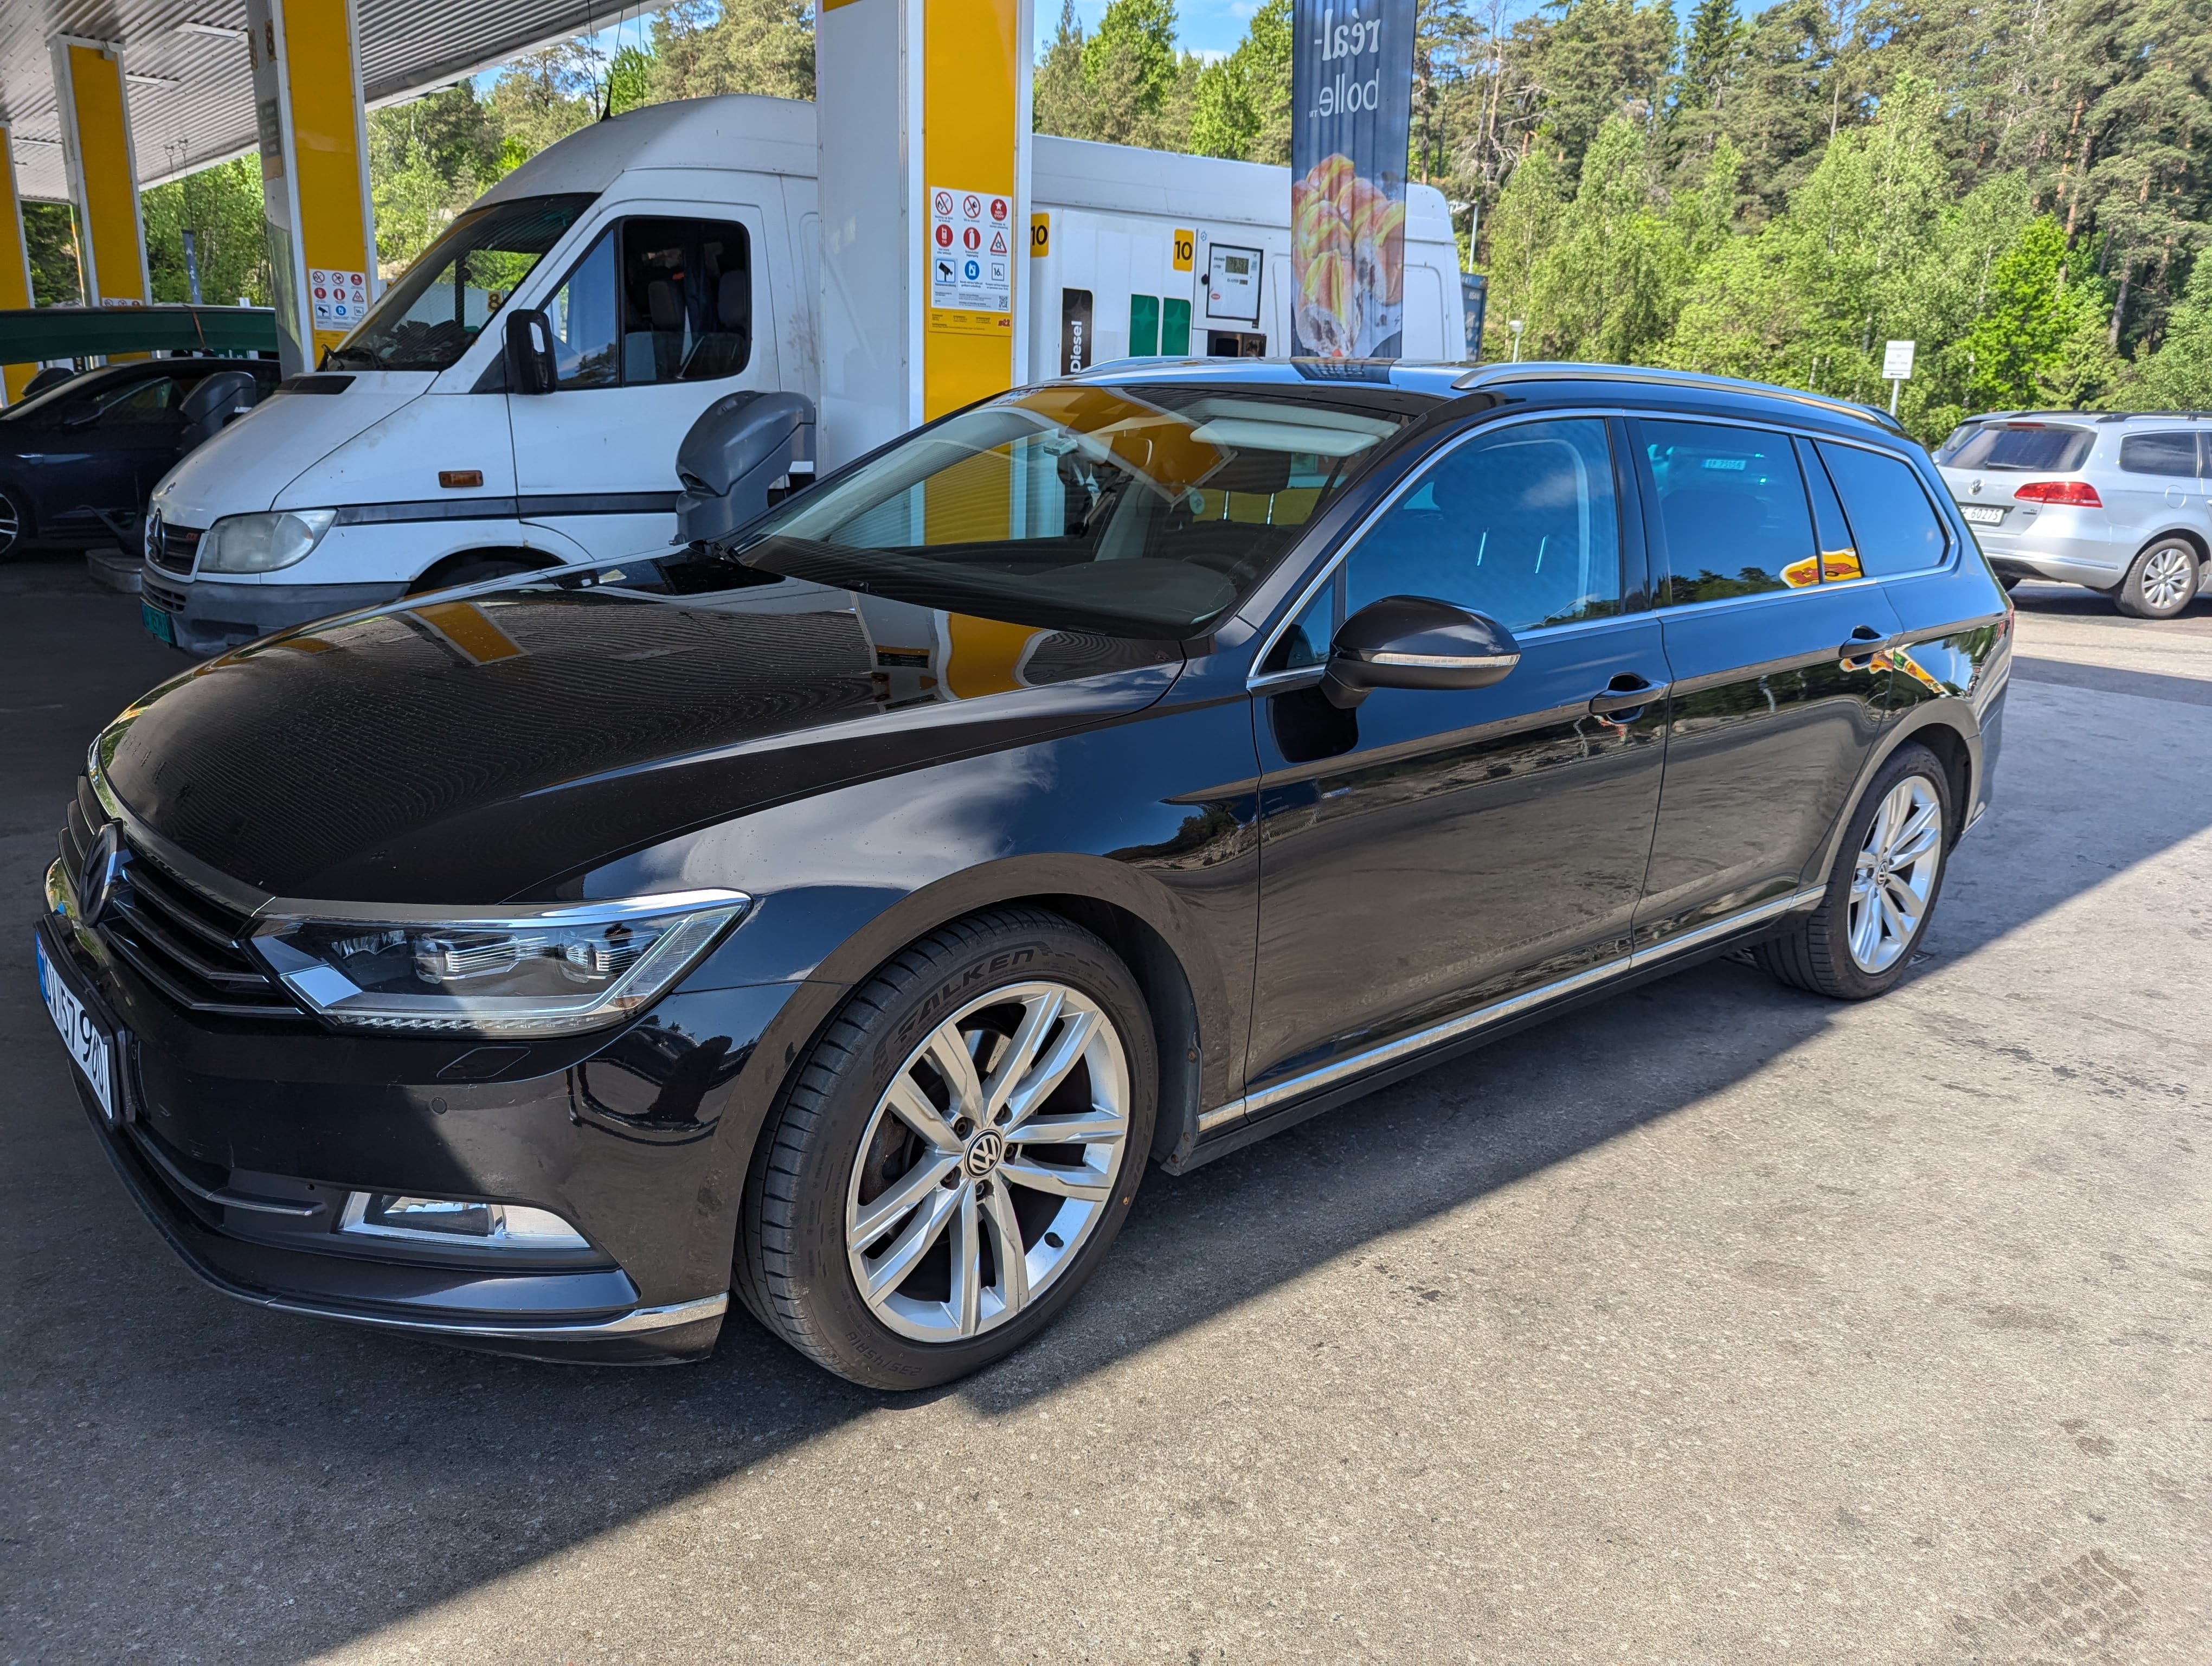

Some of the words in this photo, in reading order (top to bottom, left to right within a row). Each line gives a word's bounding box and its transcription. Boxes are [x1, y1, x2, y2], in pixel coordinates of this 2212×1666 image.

[1031, 225, 1047, 246] 10
[1175, 241, 1192, 260] 10
[1070, 321, 1082, 373] Diesel
[1971, 507, 2000, 521] 60275
